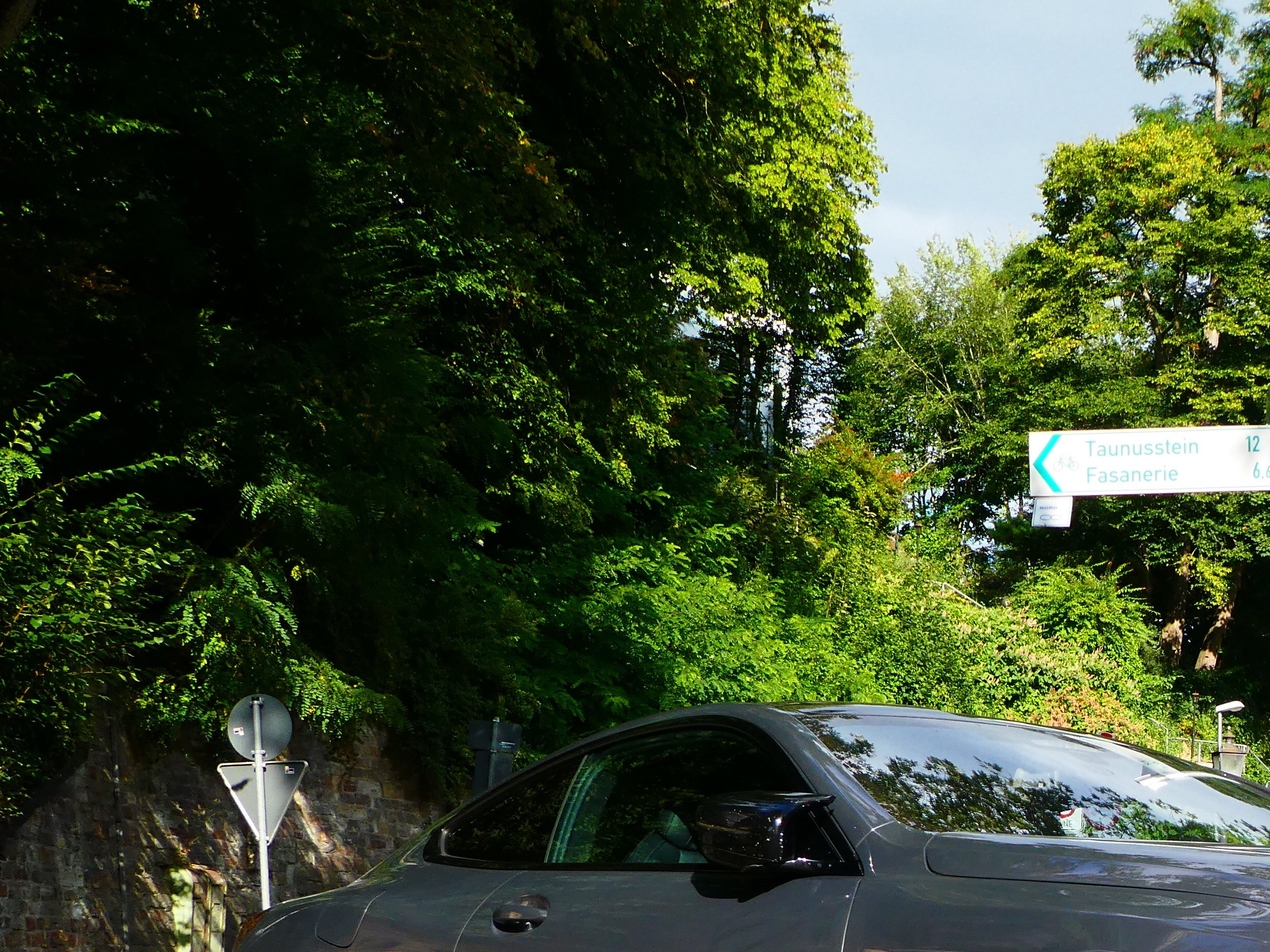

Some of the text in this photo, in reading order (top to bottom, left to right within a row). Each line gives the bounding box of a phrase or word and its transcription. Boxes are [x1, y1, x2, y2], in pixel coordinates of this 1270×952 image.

[1085, 435, 1260, 458] Taunusstein 12
[1086, 466, 1179, 484] Fasanerie
